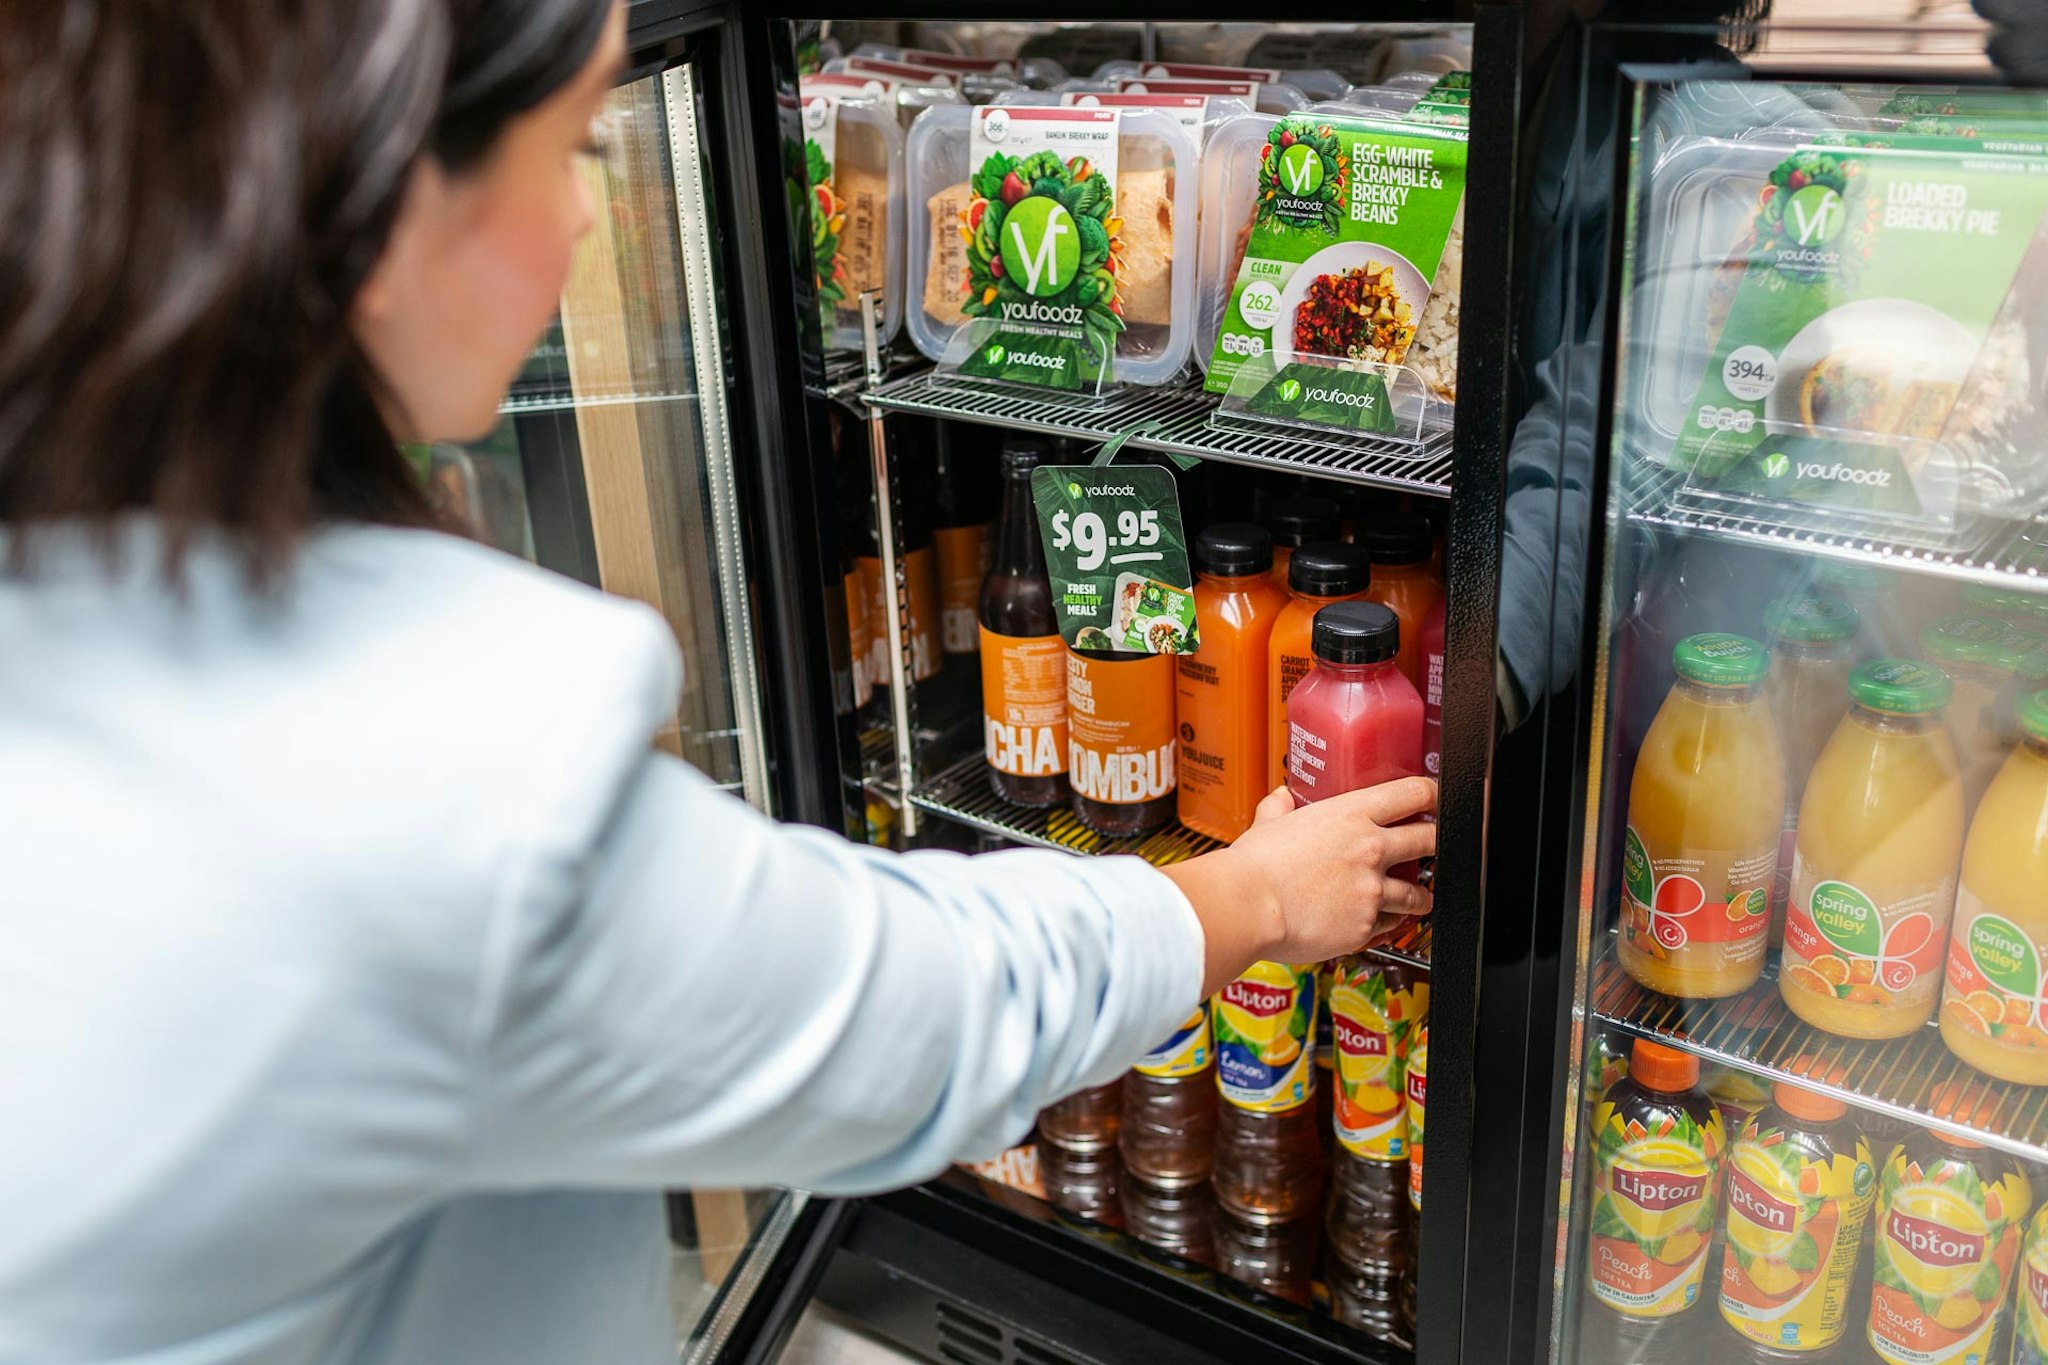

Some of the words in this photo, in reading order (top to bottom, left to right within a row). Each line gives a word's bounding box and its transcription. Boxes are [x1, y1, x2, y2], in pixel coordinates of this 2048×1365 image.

[1092, 132, 1108, 141] WRAP
[1983, 141, 2042, 153] VEGETARIAN
[1352, 143, 1433, 169] EGG-WHITE
[1352, 163, 1428, 188] SCRAMBLE
[1430, 170, 1442, 190] &
[1276, 198, 1323, 212] youfoodz
[1351, 183, 1409, 206] BREKKY
[1887, 182, 1968, 207] LOADED
[1350, 203, 1398, 225] BEANS
[1884, 205, 1964, 233] BREKKY
[1966, 210, 2000, 236] PIE
[1777, 248, 1840, 264] youfoodz
[1250, 262, 1282, 276] CLEAN
[1001, 300, 1083, 324] youfoodz
[1246, 293, 1273, 312] 262
[1024, 326, 1057, 337] HEALTHY
[1058, 328, 1083, 339] MEALS
[1006, 350, 1066, 370] youfoodz
[1728, 360, 1765, 381] 394
[1304, 386, 1375, 409] youfoodz
[1796, 462, 1892, 487] youfoodz
[1085, 484, 1135, 498] youfoodz
[1052, 509, 1160, 571] $9.95
[1062, 594, 1102, 605] HEALTHY
[1067, 584, 1096, 595] FRESH
[1067, 605, 1097, 616] MEALS
[1281, 655, 1309, 666] CARROT
[1291, 721, 1327, 751] WATERMELON
[1291, 732, 1306, 750] APPLE
[1182, 746, 1225, 770] YOUJUICE
[1291, 744, 1326, 771] STRAWBERRY
[1291, 763, 1316, 787] BEETROOT
[1816, 893, 1868, 920] spring
[1739, 918, 1766, 934] orange
[1787, 916, 1817, 947] orange
[1815, 908, 1866, 935] valley
[1974, 926, 2025, 959] spring
[1972, 941, 2022, 973] valley
[1226, 984, 1287, 1009] Lipton
[1337, 1026, 1380, 1051] pton
[1221, 1050, 1266, 1080] Lemon
[1620, 1173, 1698, 1203] Lipton
[1893, 1217, 1975, 1258] Lipton
[1599, 1246, 1652, 1280] Peach
[1598, 1283, 1612, 1294] LOW
[1612, 1289, 1620, 1297] IN
[1621, 1291, 1655, 1301] CALORIES
[1614, 1274, 1632, 1290] TEA
[1720, 1295, 1744, 1310] ALORIES
[1876, 1295, 1927, 1337] Peach
[1876, 1334, 1889, 1347] LOW
[1889, 1341, 1897, 1350] IN
[1897, 1346, 1930, 1359] CALORIES
[1893, 1328, 1907, 1344] TEA
